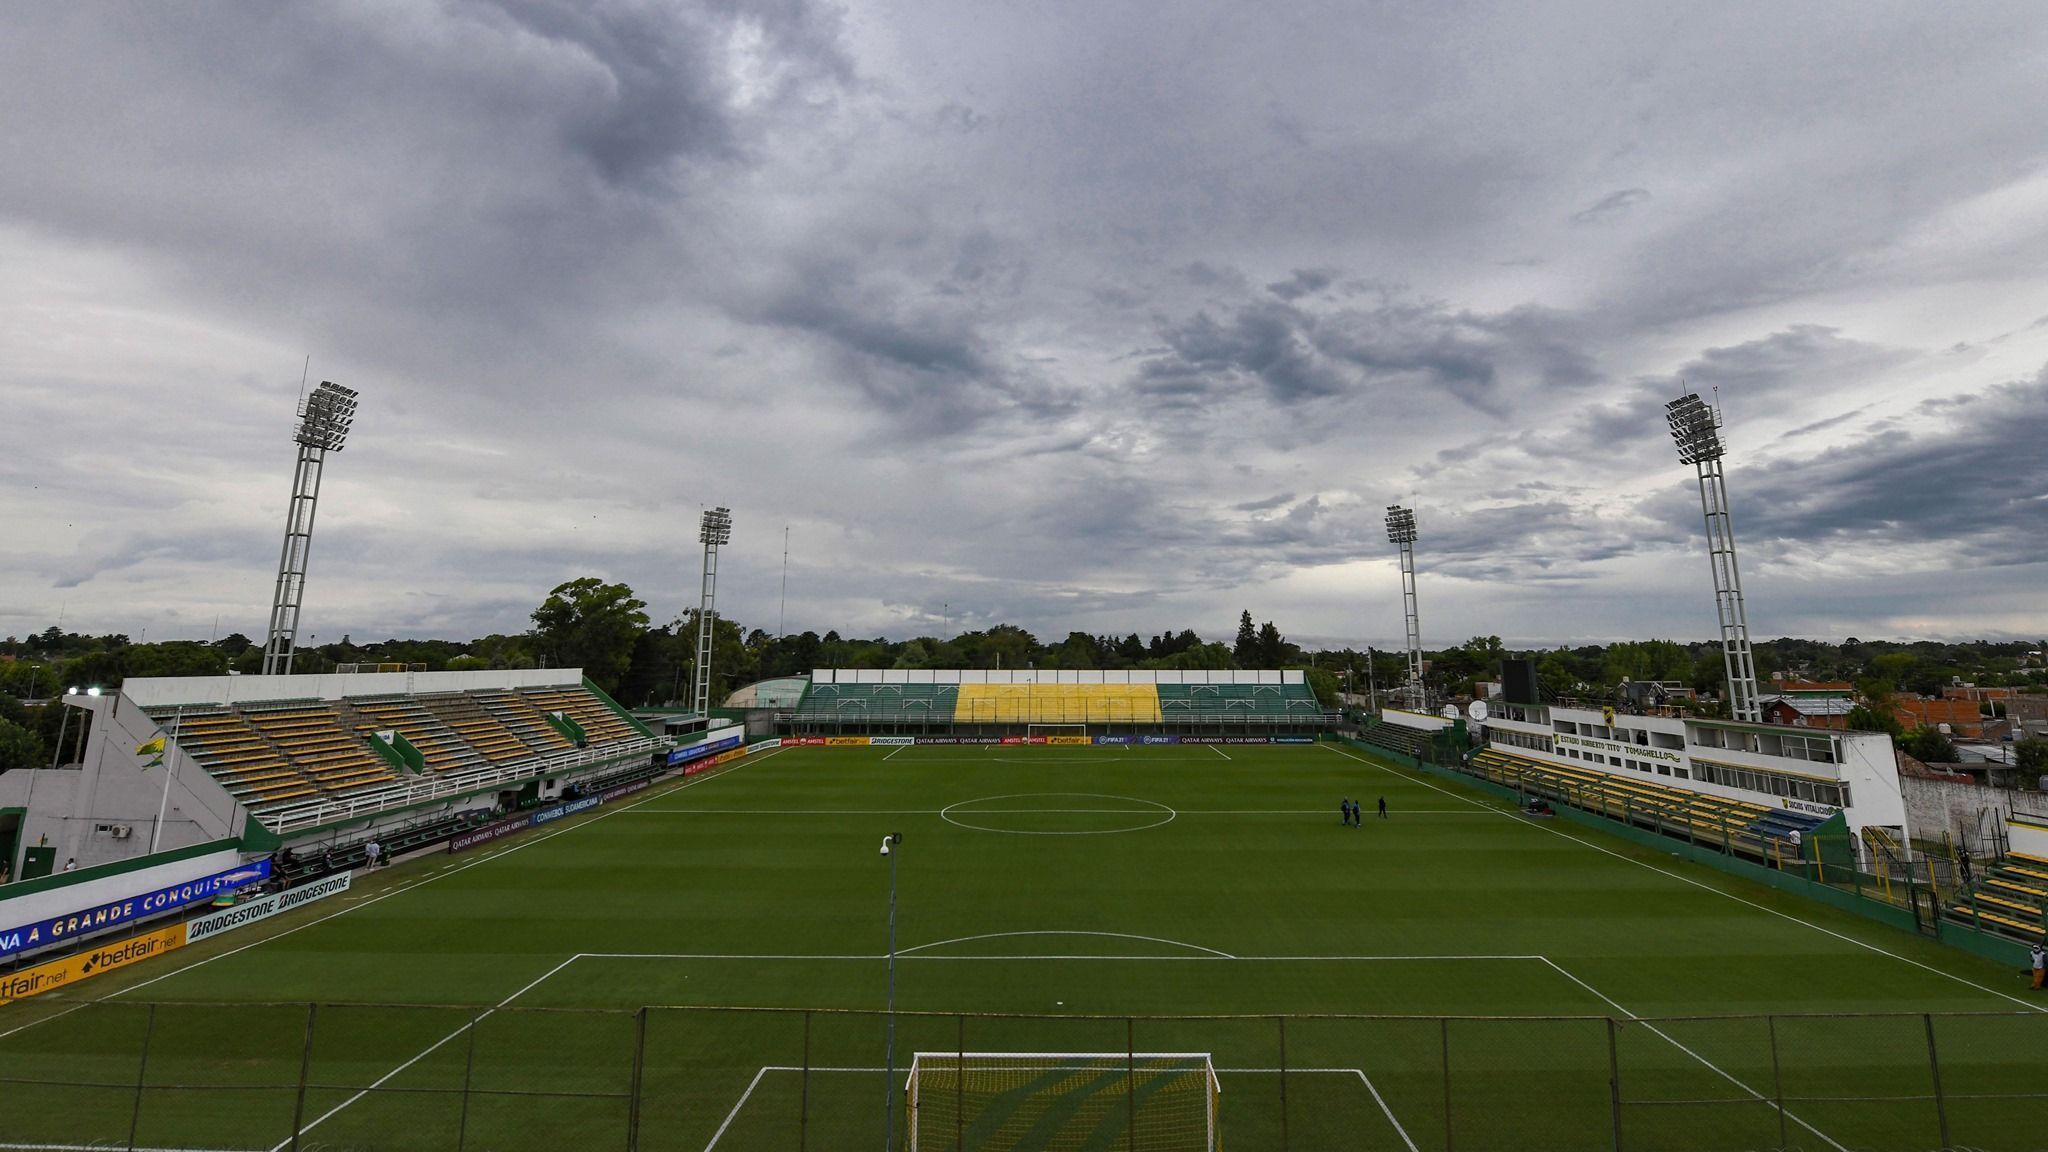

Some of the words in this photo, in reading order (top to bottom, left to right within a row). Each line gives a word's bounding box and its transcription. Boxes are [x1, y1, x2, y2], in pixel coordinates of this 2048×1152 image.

[1561, 735, 1580, 745] ESTADIO
[453, 837, 471, 850] QATAR
[472, 831, 492, 842] AIRWAYS
[494, 824, 510, 836] QATAR
[511, 818, 529, 829] AIRWAYS
[278, 875, 349, 910] BRIDGESTONE
[27, 927, 40, 944] A
[52, 902, 134, 937] GRANDE
[143, 875, 239, 911] CONQUIST
[188, 900, 275, 940] BRIDGESTONE
